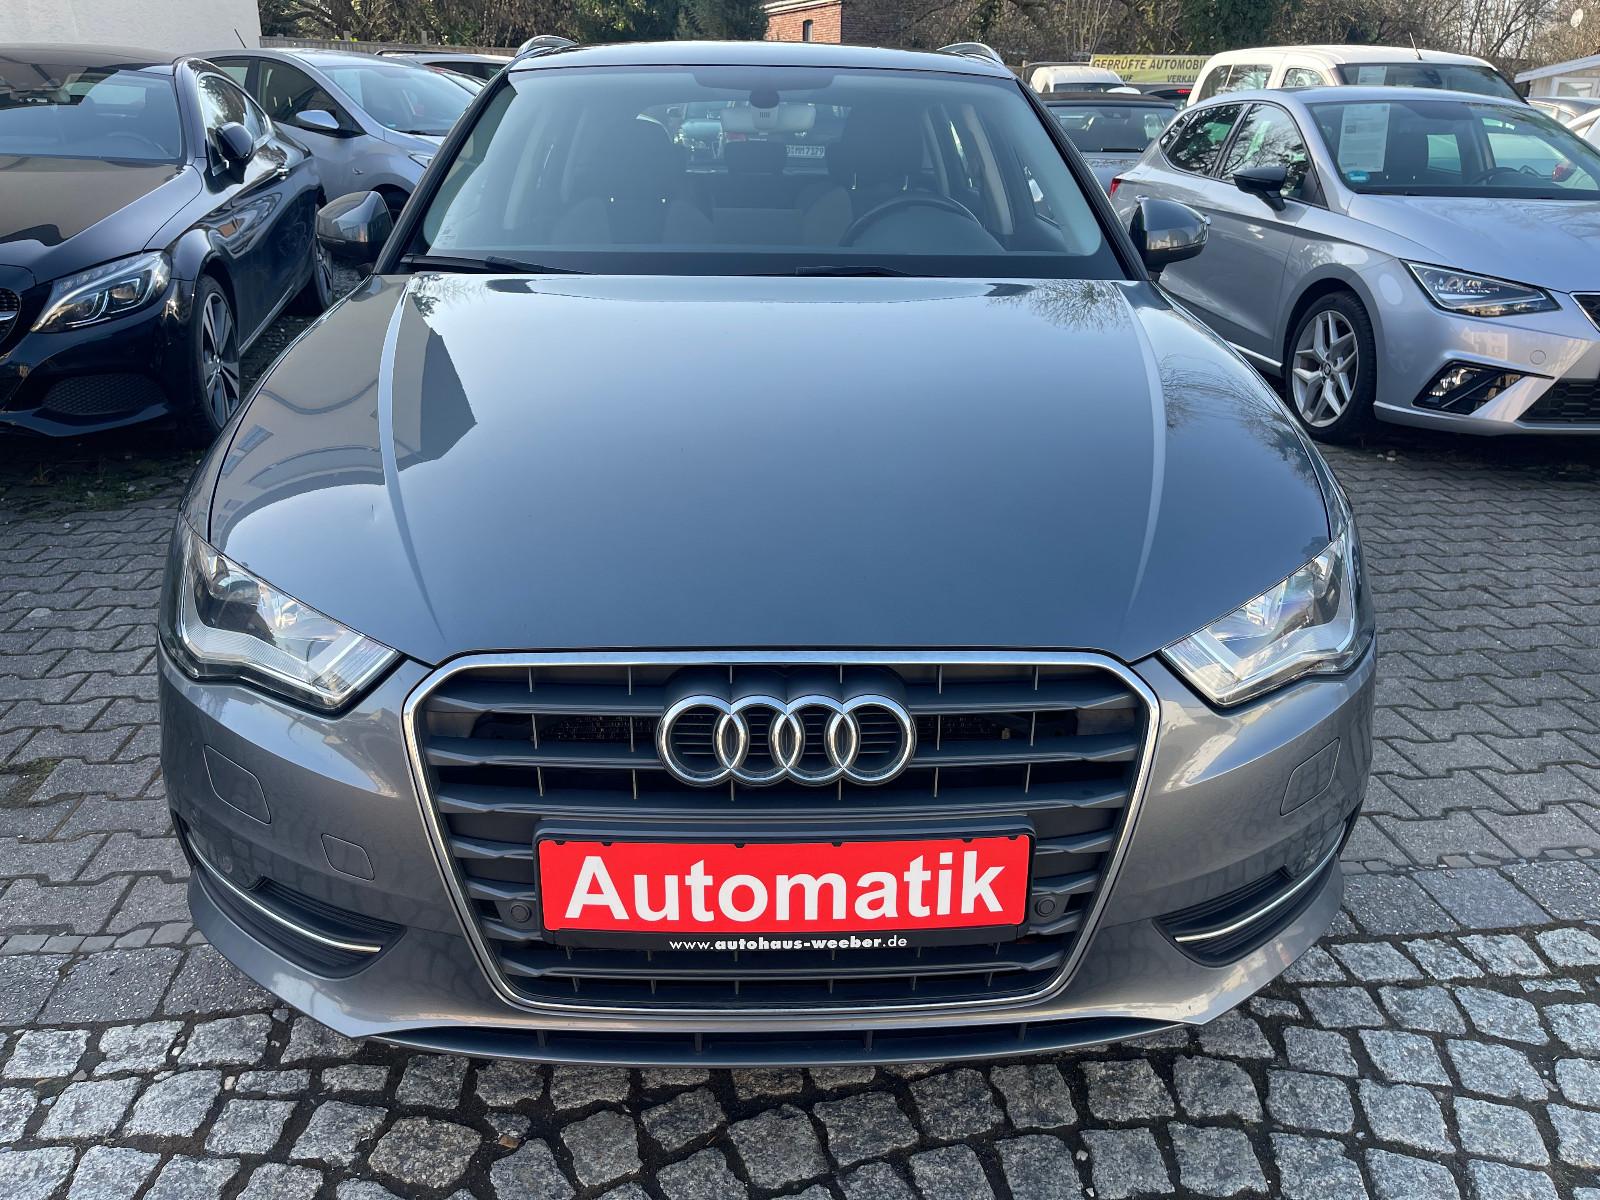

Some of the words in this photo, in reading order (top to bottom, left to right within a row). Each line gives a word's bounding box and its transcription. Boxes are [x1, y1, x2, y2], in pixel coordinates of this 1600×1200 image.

[1094, 56, 1149, 70] GEPRÜFTE
[565, 851, 1005, 922] Automatik
[669, 935, 907, 950] www.autohaus-weeber.de
